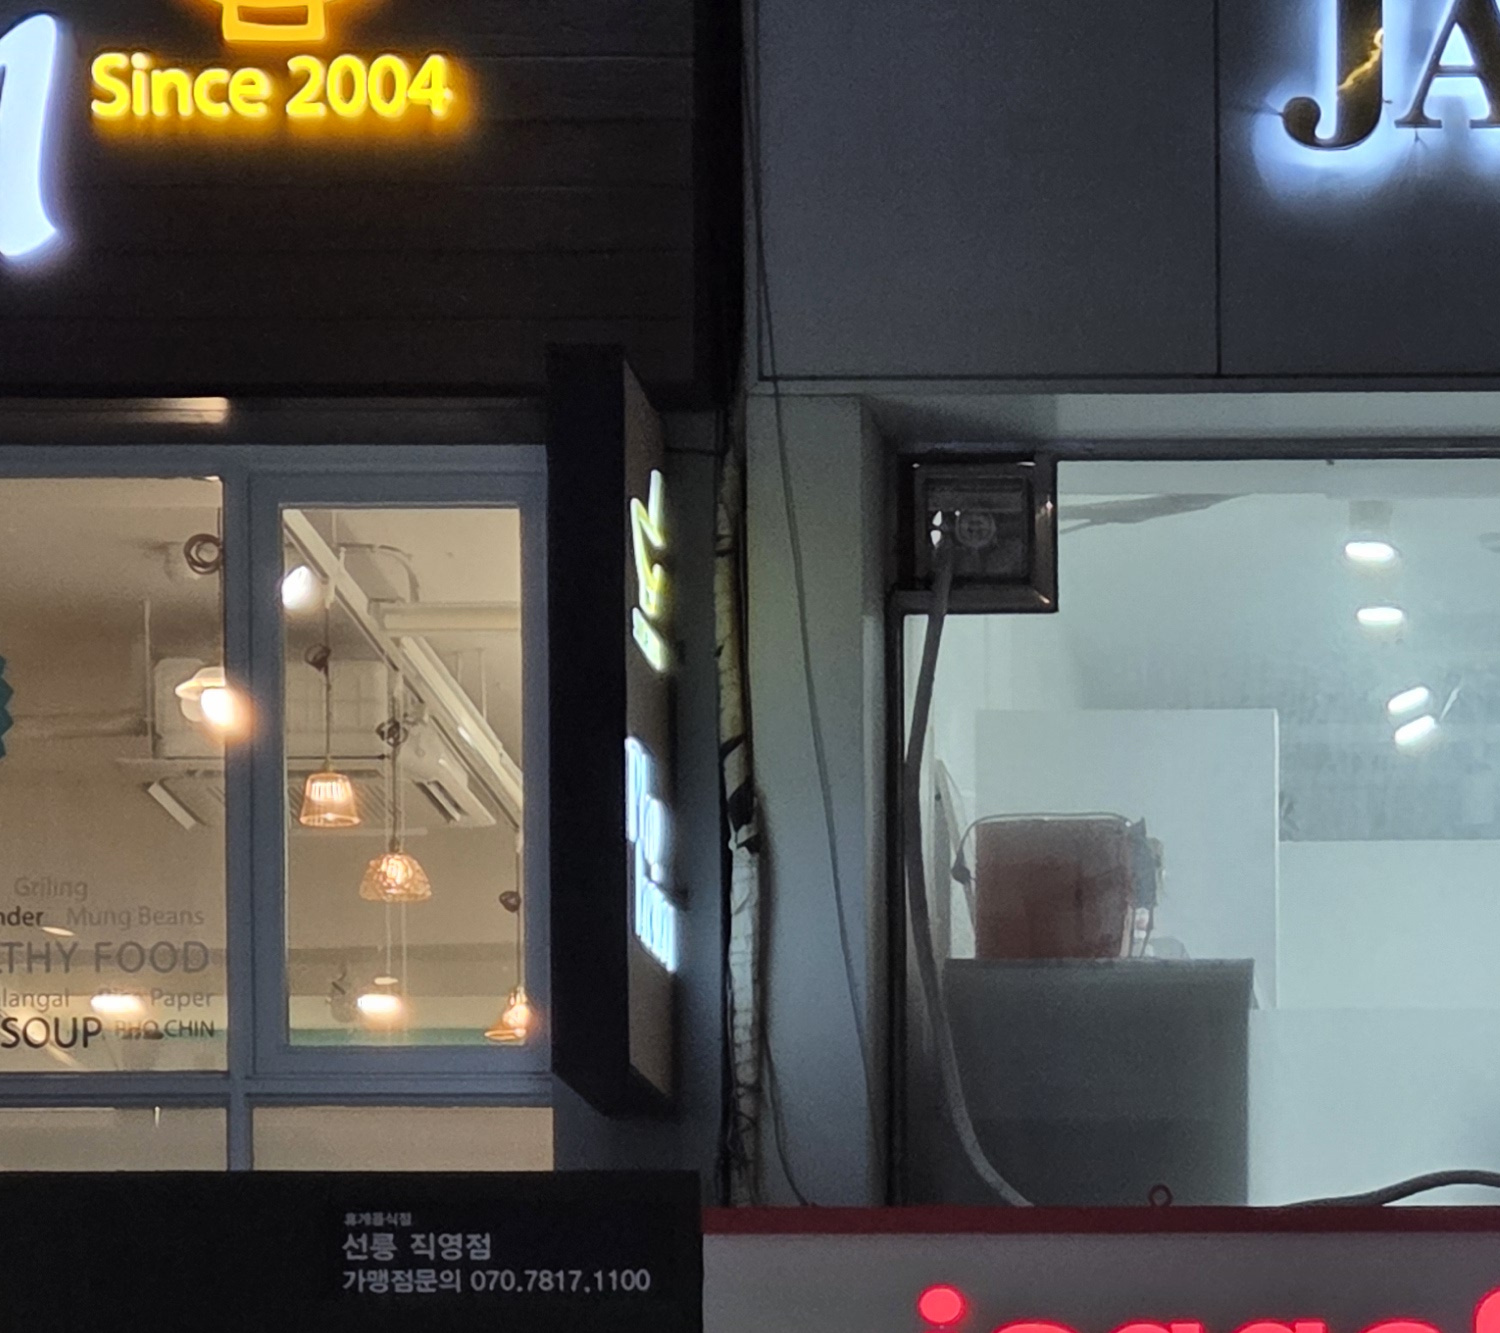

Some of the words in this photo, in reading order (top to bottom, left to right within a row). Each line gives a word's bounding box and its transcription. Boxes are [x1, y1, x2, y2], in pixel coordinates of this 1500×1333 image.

[91, 52, 271, 117] Since
[286, 54, 452, 117] 2004
[138, 906, 205, 926] Beans
[0, 942, 78, 974] THY
[95, 941, 209, 974] FOOD
[151, 988, 214, 1011] Paper
[342, 1232, 397, 1261] 선릉
[410, 1232, 491, 1261] 직영점
[342, 1268, 462, 1293] 가맹점문의
[470, 1269, 651, 1293] 070.7817.1100
